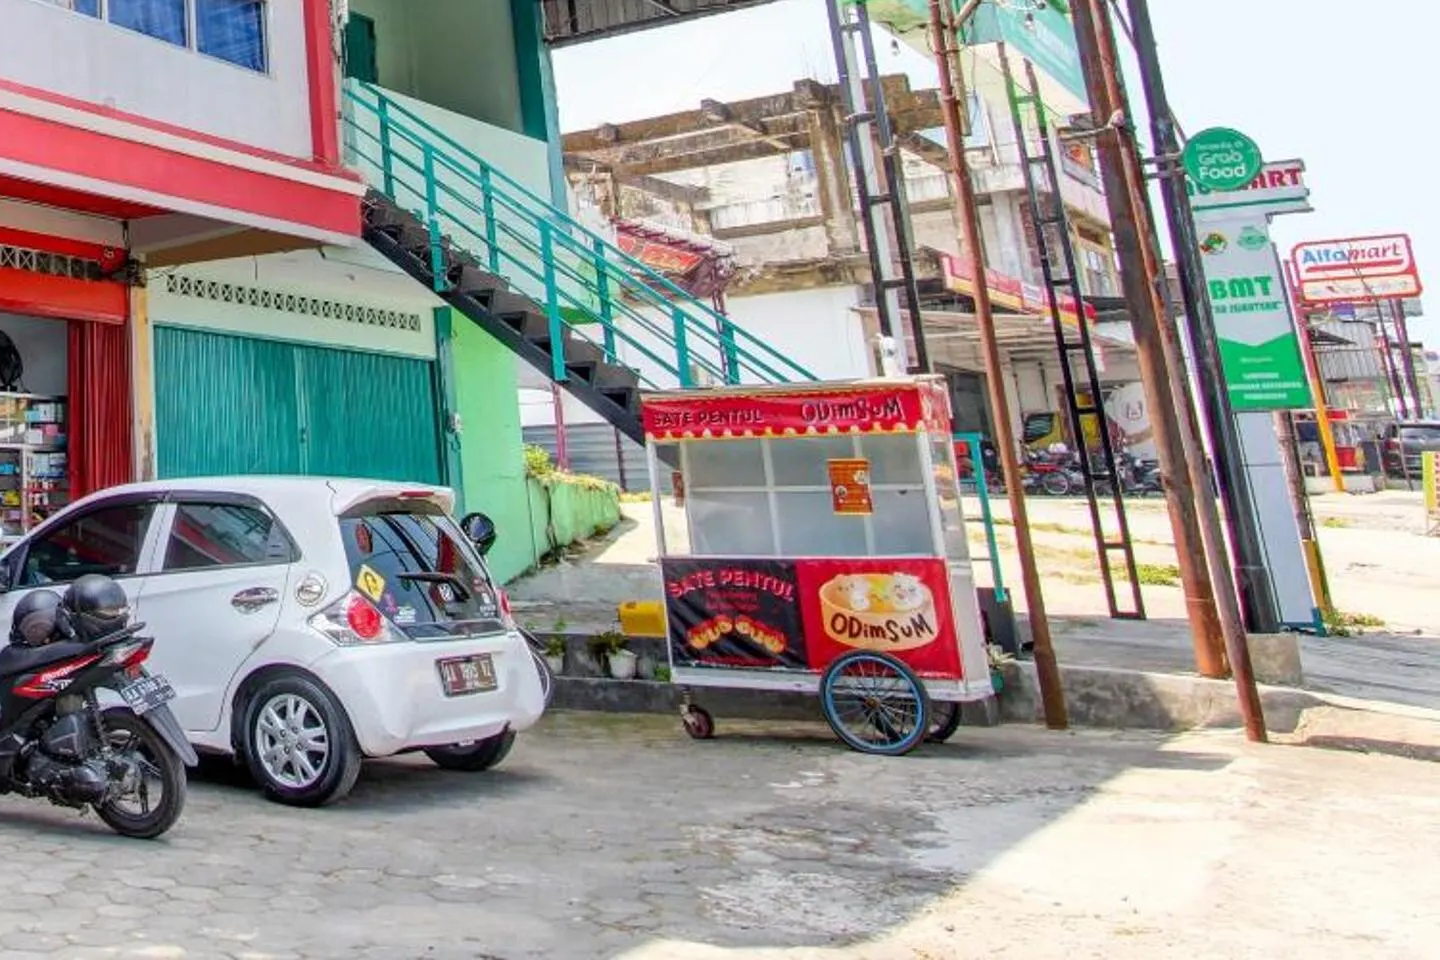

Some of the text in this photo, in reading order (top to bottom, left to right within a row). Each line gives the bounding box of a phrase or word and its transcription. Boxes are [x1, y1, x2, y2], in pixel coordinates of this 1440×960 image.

[1199, 148, 1242, 166] Grab
[1199, 163, 1246, 180] Food
[1209, 276, 1272, 300] BMT
[653, 411, 692, 427] SATE
[668, 569, 716, 598] SATE
[719, 568, 795, 602] PENTUL
